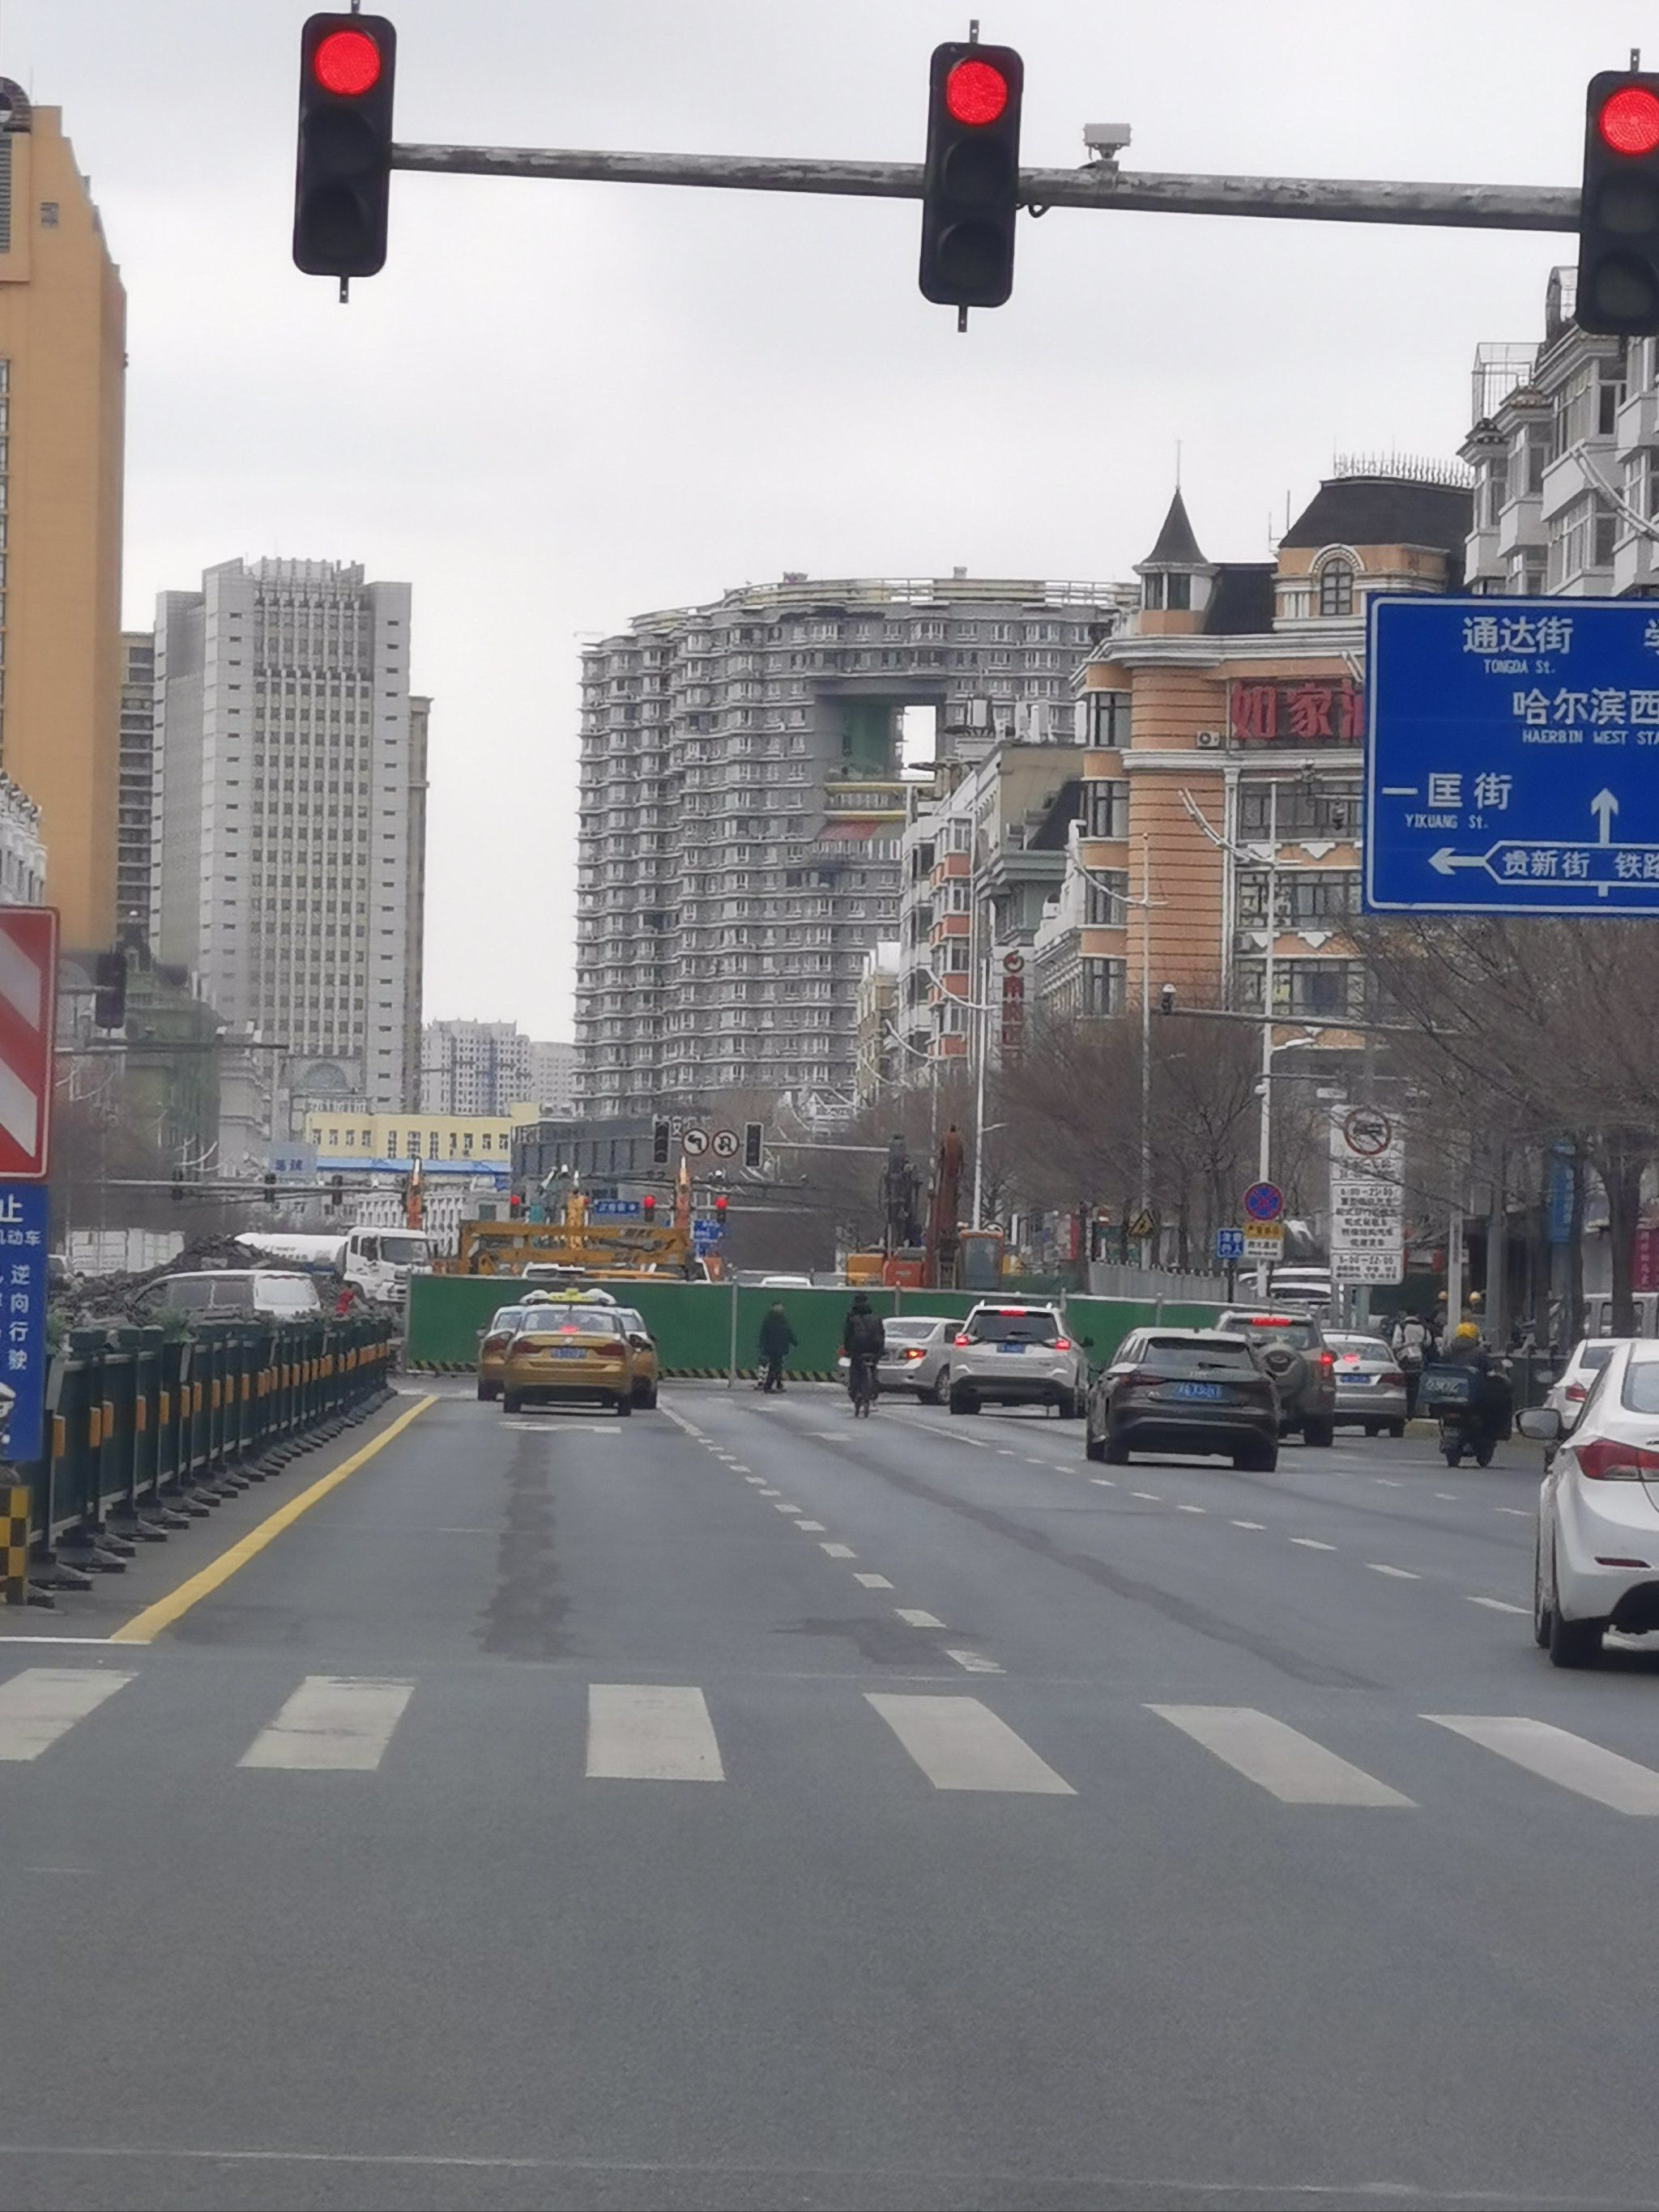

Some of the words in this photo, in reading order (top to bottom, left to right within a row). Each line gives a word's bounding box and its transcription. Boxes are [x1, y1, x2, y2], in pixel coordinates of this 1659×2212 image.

[1461, 616, 1574, 654] 通达街
[1483, 658, 1529, 675] TONGDA
[1512, 687, 1659, 725] 哈尔滨西
[1522, 729, 1584, 744] HAERBIN
[1593, 730, 1629, 745] WEST
[1381, 772, 1513, 810] 一匡街
[9, 1264, 30, 1370] 逆向行驶
